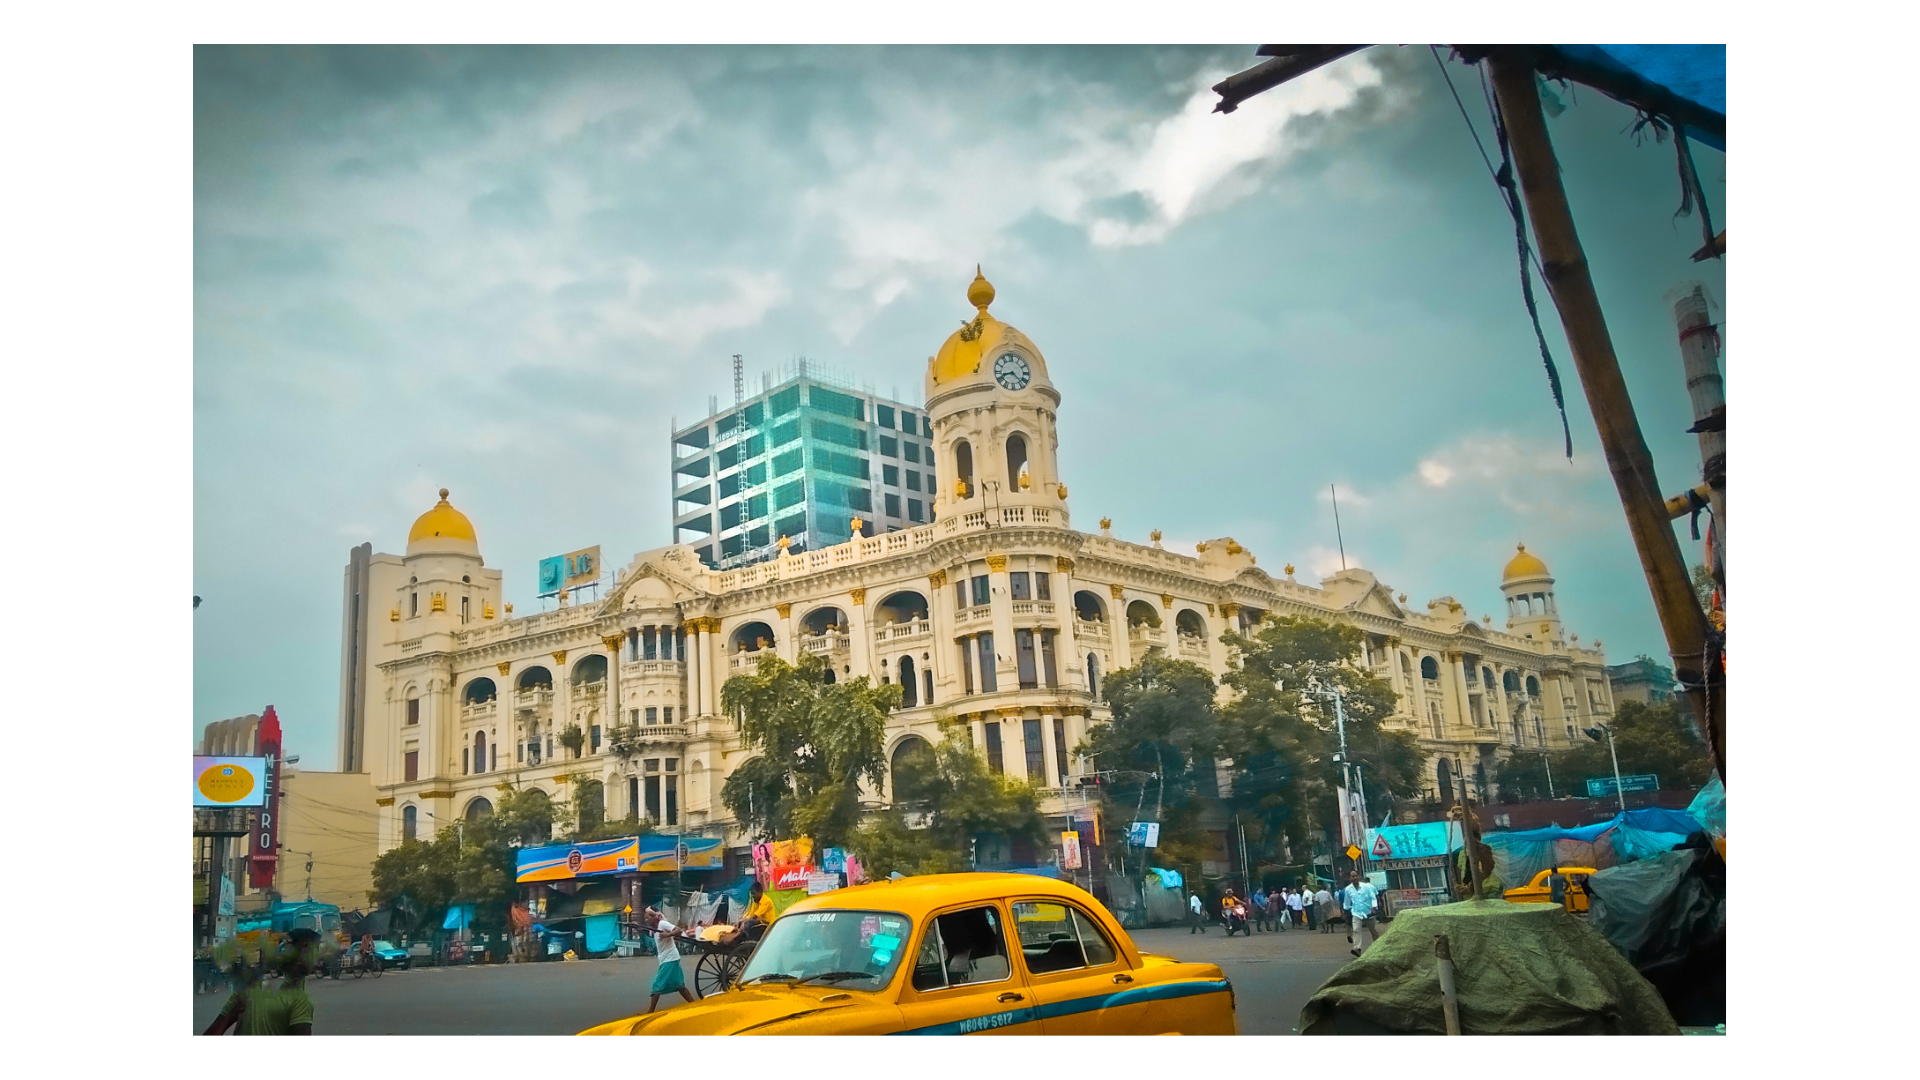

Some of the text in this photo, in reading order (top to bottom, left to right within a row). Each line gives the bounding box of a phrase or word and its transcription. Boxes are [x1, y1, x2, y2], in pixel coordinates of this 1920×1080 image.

[566, 553, 592, 579] LIC
[260, 753, 275, 849] METRO
[625, 857, 636, 866] LIC
[1414, 858, 1445, 869] POLICE
[805, 913, 837, 923] SIKHA
